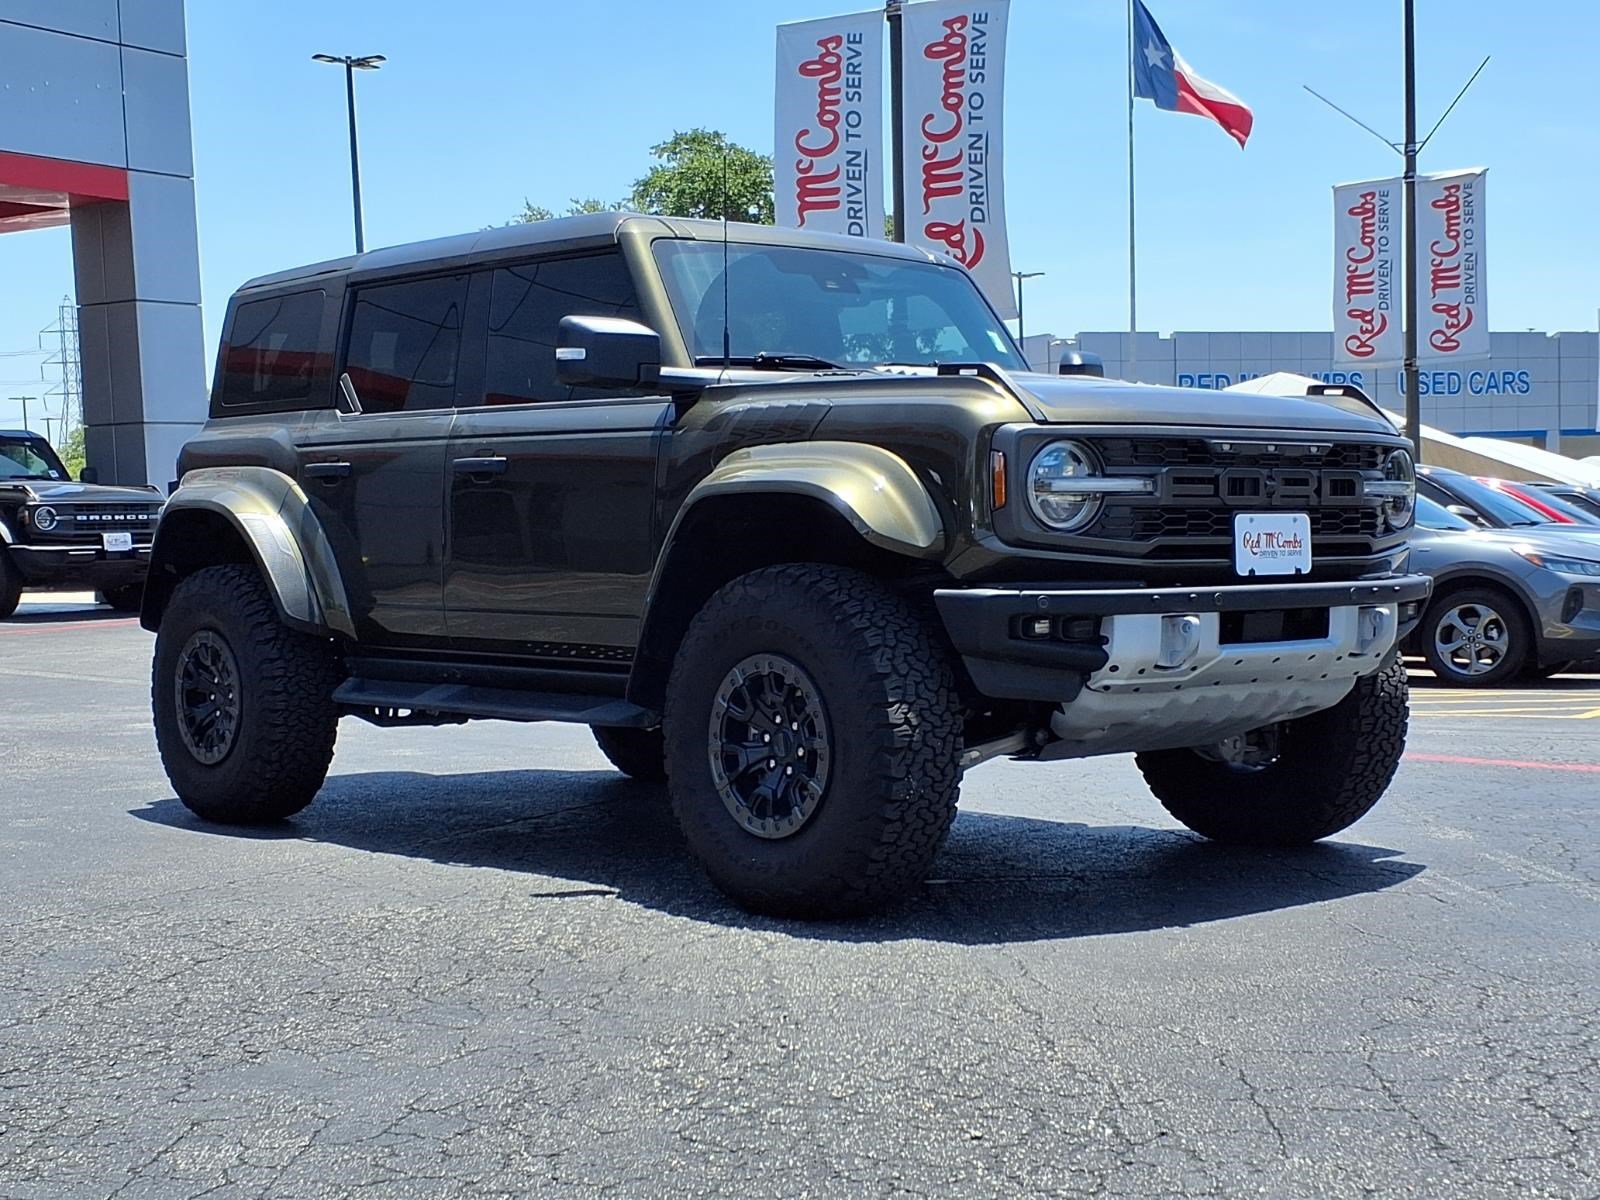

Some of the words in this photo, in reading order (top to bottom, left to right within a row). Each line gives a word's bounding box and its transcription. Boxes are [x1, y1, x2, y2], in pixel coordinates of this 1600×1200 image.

[845, 32, 863, 103] SERVE
[969, 12, 989, 84] SERVE
[795, 34, 843, 227] McCombs
[845, 110, 862, 143] TO
[921, 14, 968, 215] McCombs
[967, 92, 985, 125] TO
[846, 150, 864, 237] DRIVEN
[967, 133, 985, 223] DRIVEN
[1463, 182, 1473, 224] SERVE
[1378, 189, 1390, 232] SERVE
[1346, 191, 1376, 304] McCombs
[1378, 237, 1390, 255] TO
[1430, 184, 1461, 299] McCombs
[1463, 228, 1474, 247] TO
[1378, 259, 1389, 310] DRIVEN
[1464, 253, 1475, 304] DRIVEN
[1345, 307, 1387, 357] Red
[1429, 302, 1473, 352] Red
[1469, 371, 1530, 395] CARS
[1164, 467, 1364, 506] FORD
[1243, 531, 1261, 556] Red
[1262, 531, 1303, 549] McCombs
